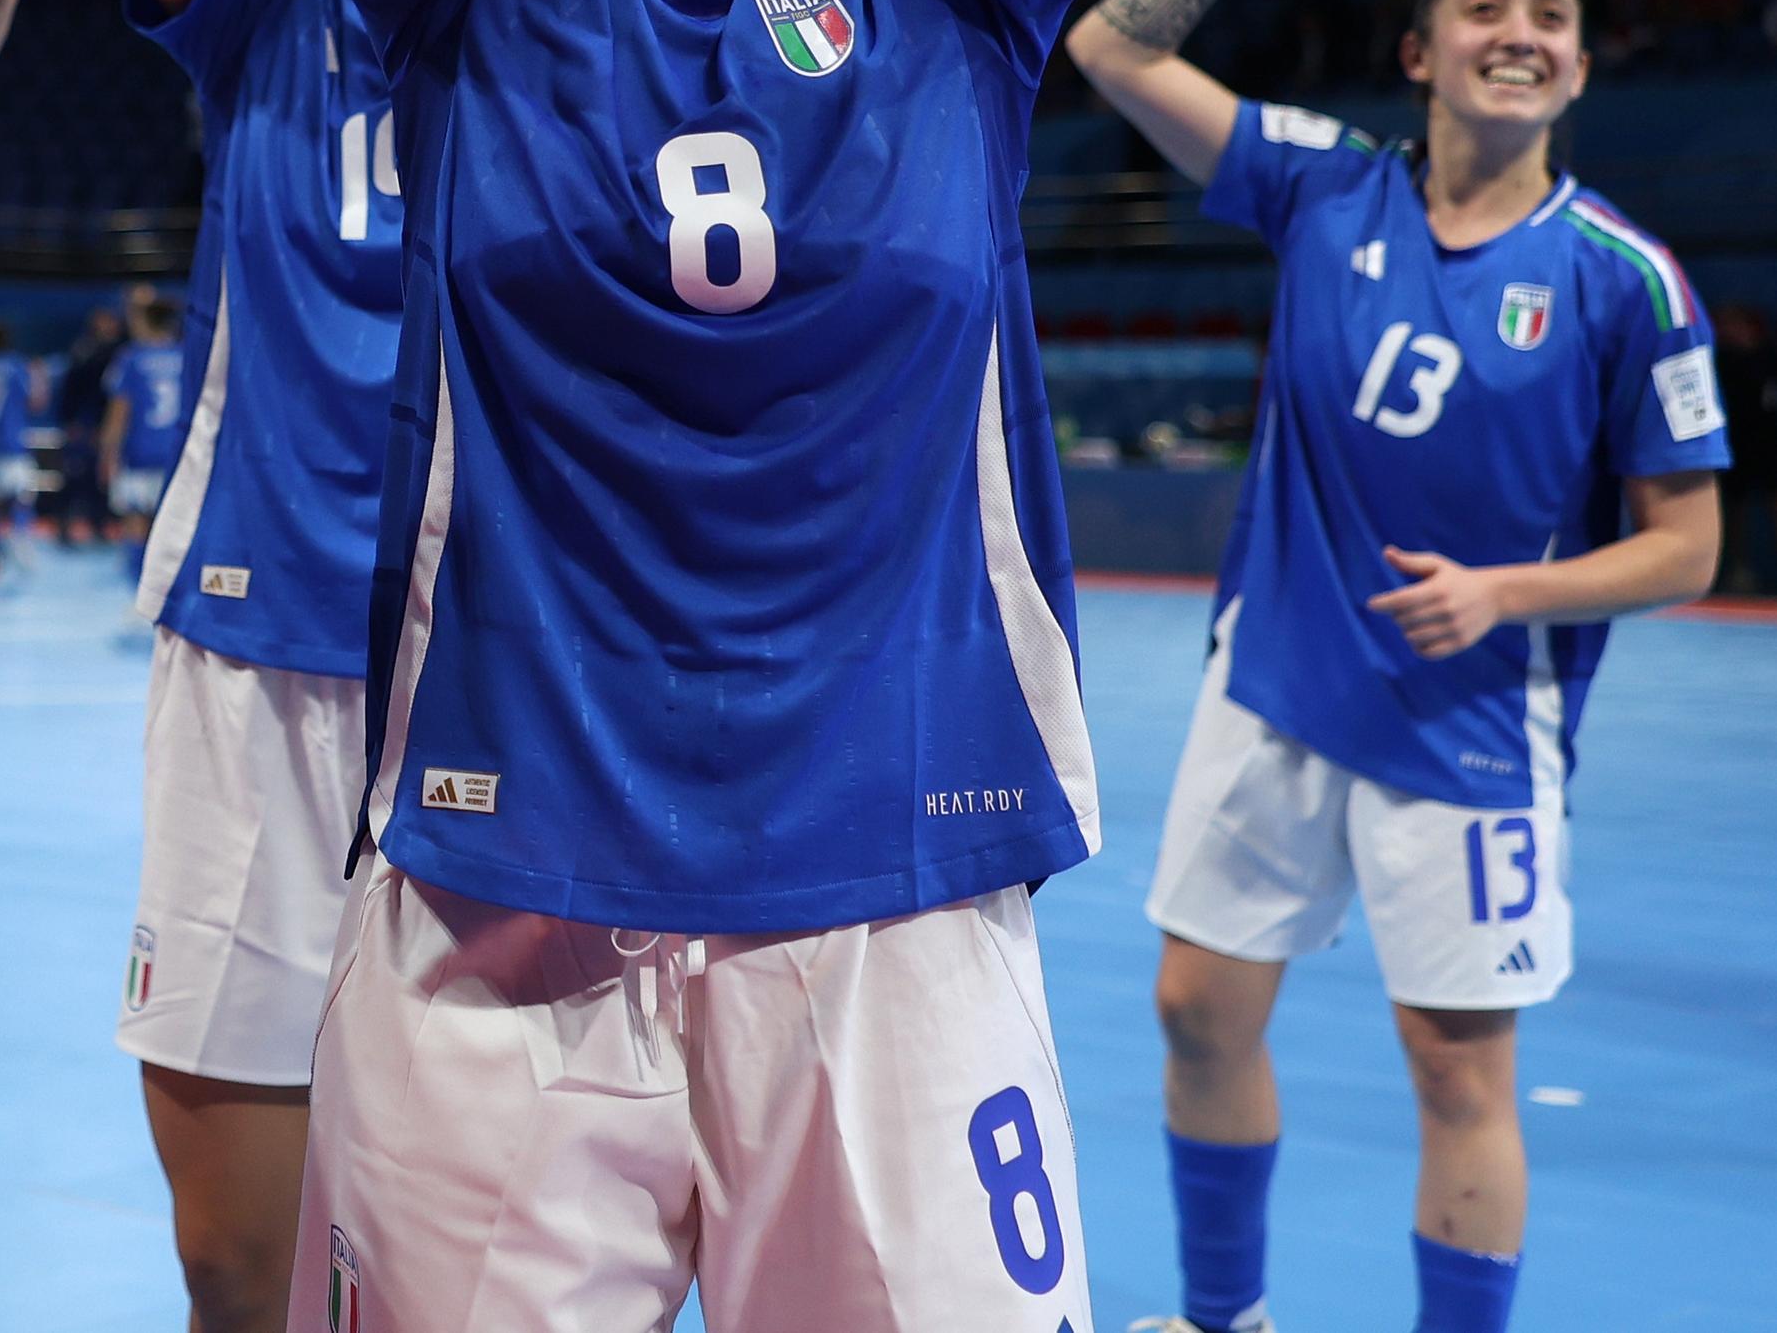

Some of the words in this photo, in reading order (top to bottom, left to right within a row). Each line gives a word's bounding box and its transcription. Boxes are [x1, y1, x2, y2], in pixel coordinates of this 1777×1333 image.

[656, 131, 776, 314] 8
[1353, 322, 1463, 438] 13
[925, 788, 1023, 816] HEAT.RDY
[1466, 817, 1536, 922] 13
[968, 1085, 1065, 1295] 8
